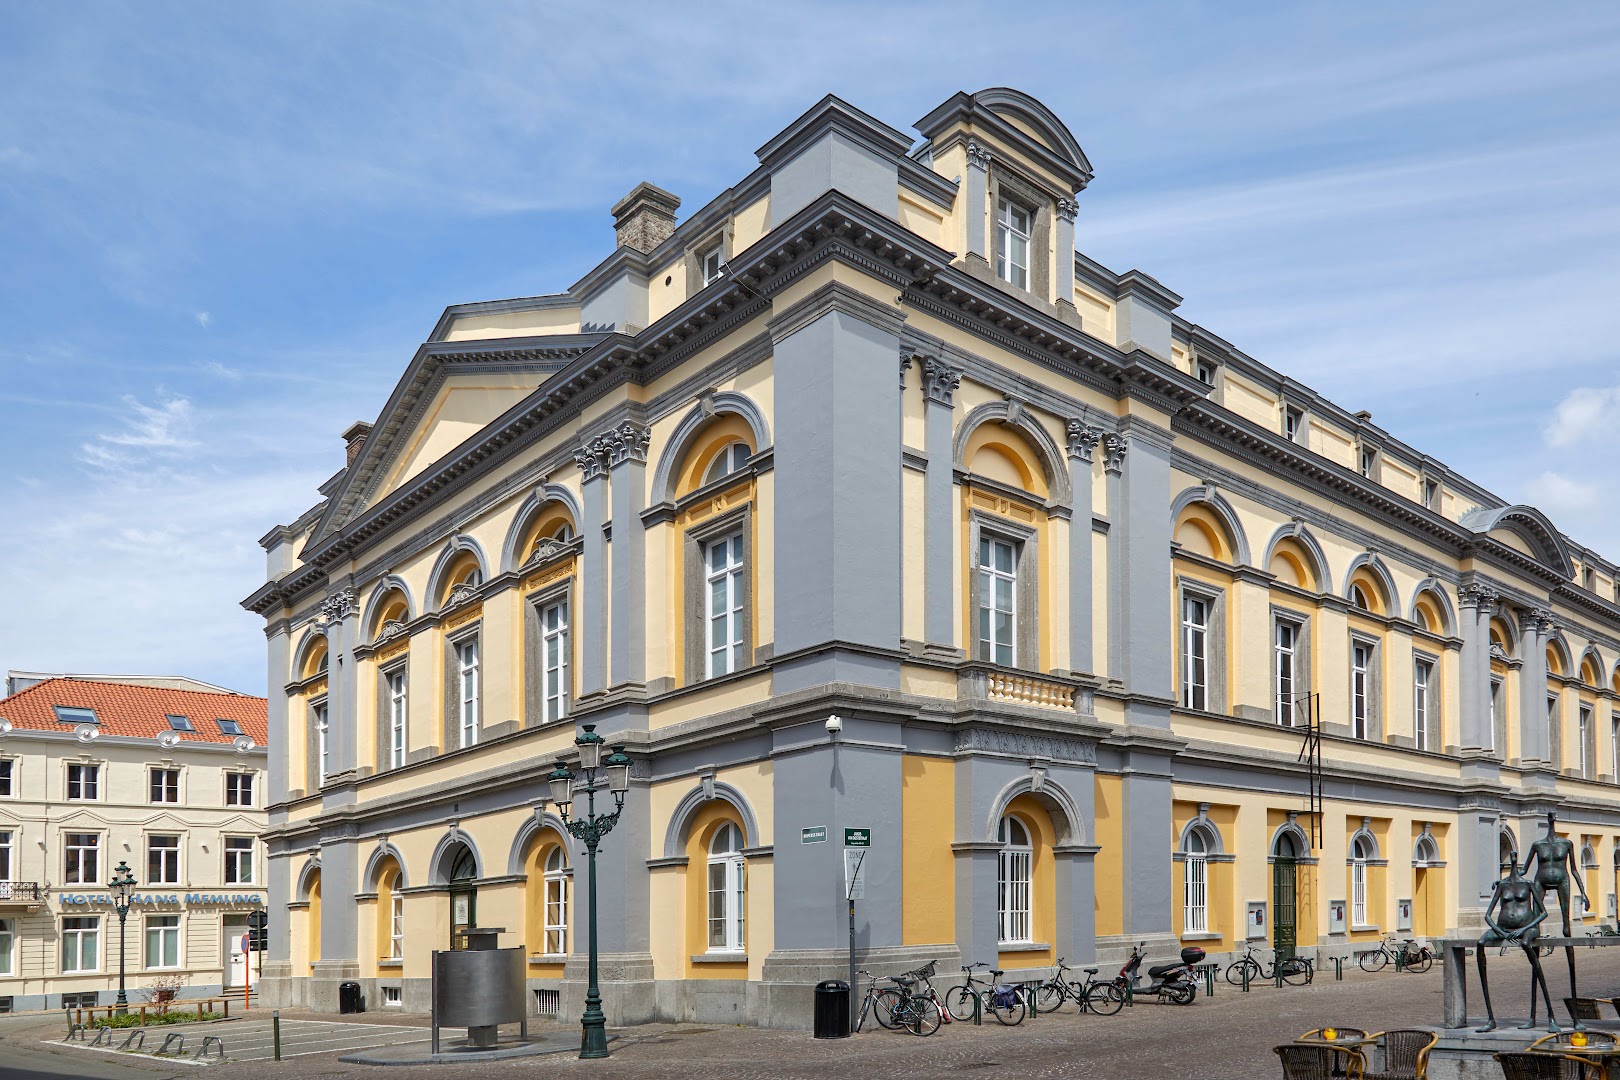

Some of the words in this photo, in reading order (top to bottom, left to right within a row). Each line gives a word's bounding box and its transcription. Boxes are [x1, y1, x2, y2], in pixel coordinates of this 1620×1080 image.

[849, 851, 862, 859] ZONE
[59, 893, 113, 904] HOTEL
[129, 893, 178, 903] HANS
[184, 893, 261, 904] MEMLING
